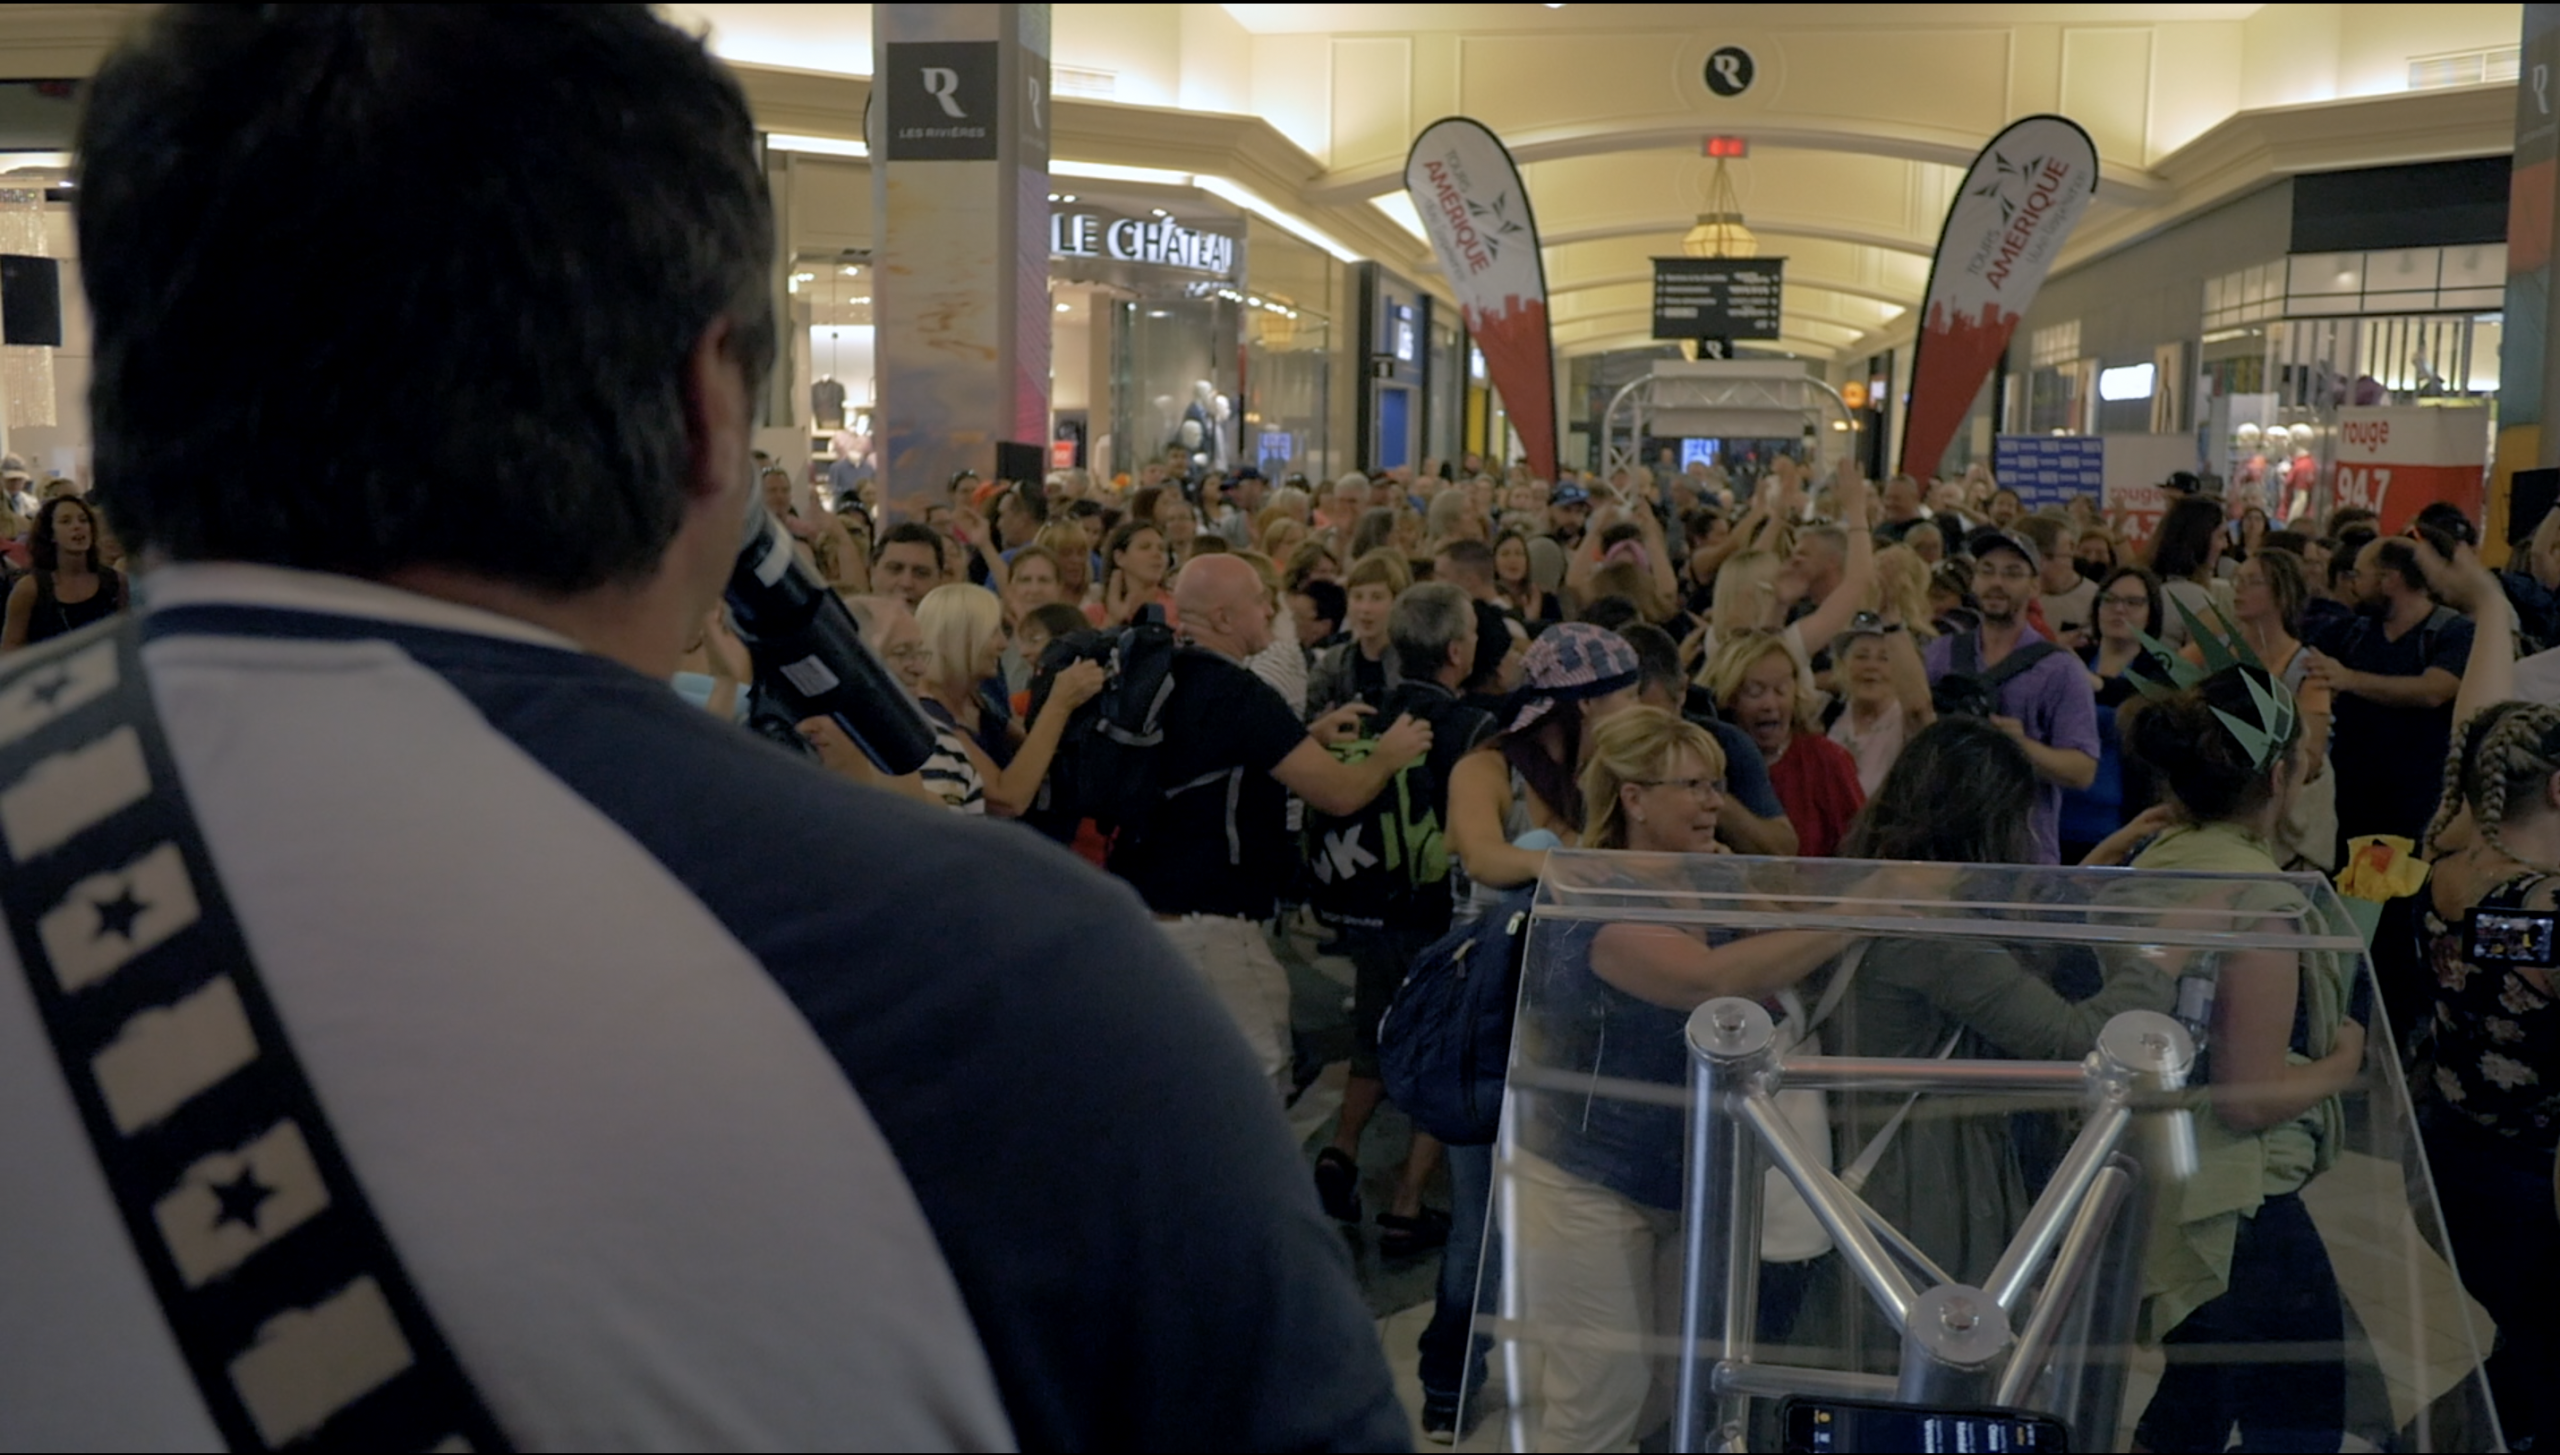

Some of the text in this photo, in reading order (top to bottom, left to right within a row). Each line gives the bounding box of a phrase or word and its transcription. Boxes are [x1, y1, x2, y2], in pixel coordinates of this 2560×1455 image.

[898, 127, 924, 139] LES
[1051, 213, 1098, 257] LE
[2342, 420, 2390, 453] rouge
